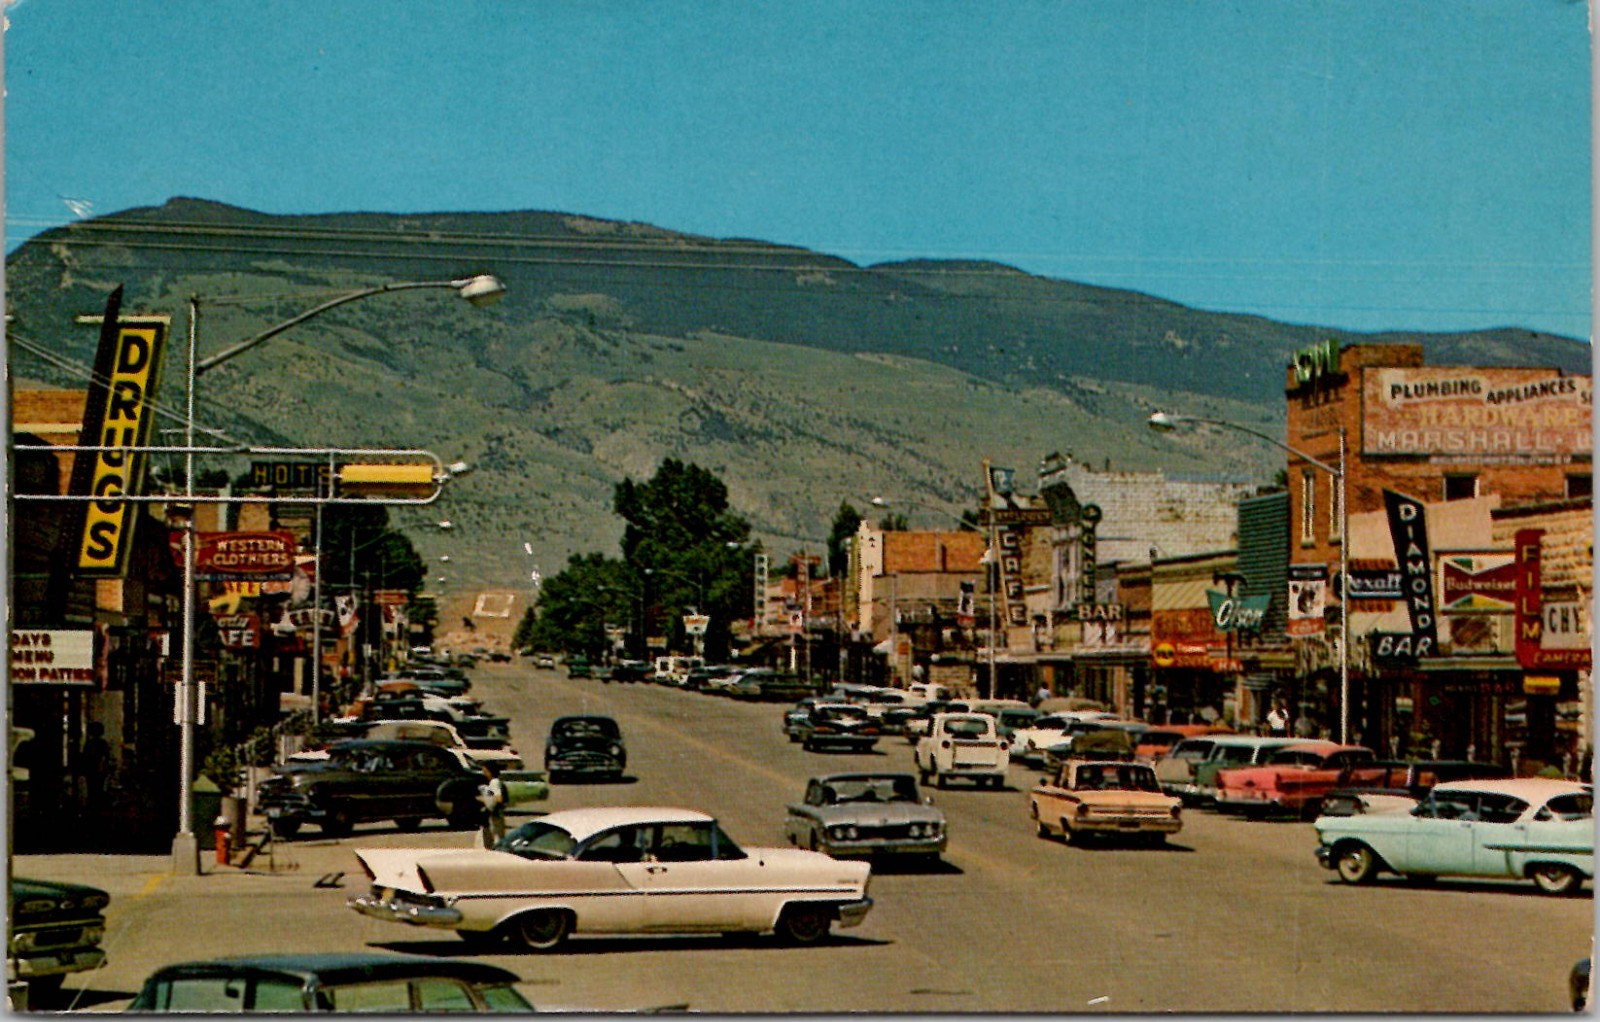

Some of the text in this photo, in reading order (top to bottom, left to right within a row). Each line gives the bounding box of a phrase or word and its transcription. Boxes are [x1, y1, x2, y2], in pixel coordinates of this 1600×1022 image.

[1390, 379, 1482, 400] PLUMBING
[1486, 378, 1577, 405] APPLIANCES
[1420, 406, 1579, 428] HARDWARE
[86, 334, 149, 560] DRUGS
[1376, 429, 1549, 450] MARSHALL
[217, 539, 285, 551] WESTERN
[213, 553, 289, 566] CLOTHIERS
[1399, 503, 1432, 630] DIAMOND
[1002, 532, 1024, 622] CAFE
[1521, 545, 1541, 641] FILM
[1078, 603, 1122, 620] BAR
[1377, 636, 1433, 657] BAR
